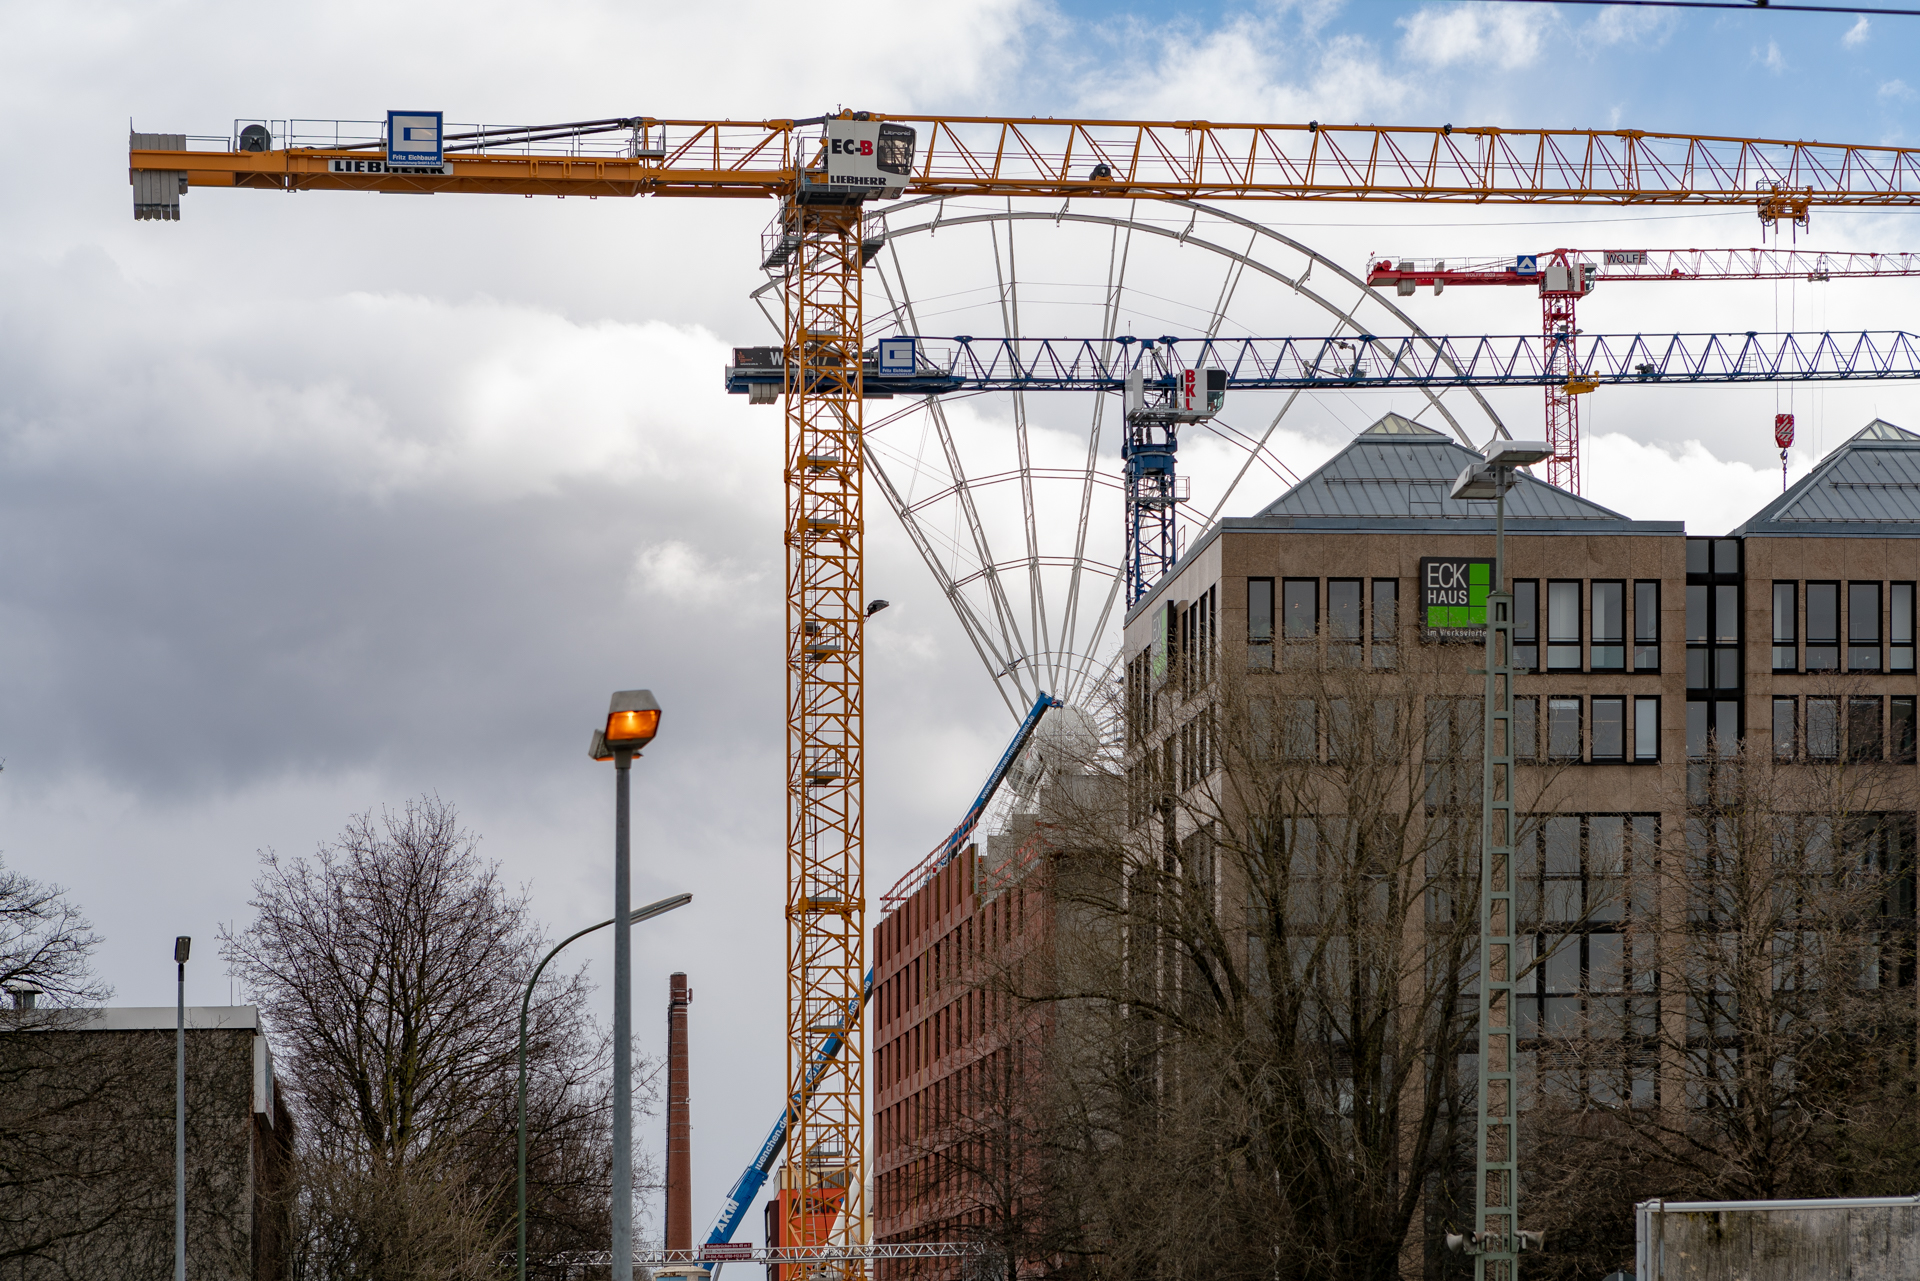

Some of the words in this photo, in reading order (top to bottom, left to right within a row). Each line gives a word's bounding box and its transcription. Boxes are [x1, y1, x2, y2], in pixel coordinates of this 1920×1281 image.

[831, 138, 874, 156] EC-B
[830, 175, 887, 185] LIEBHERR
[1606, 253, 1646, 264] WOLFF
[1184, 369, 1196, 411] BKL
[1427, 563, 1467, 588] ECK
[1427, 590, 1467, 604] HAUS
[1440, 629, 1487, 637] Werksvierte
[980, 715, 1036, 800] www.autokran-muenchen.de
[715, 1200, 740, 1233] AKM
